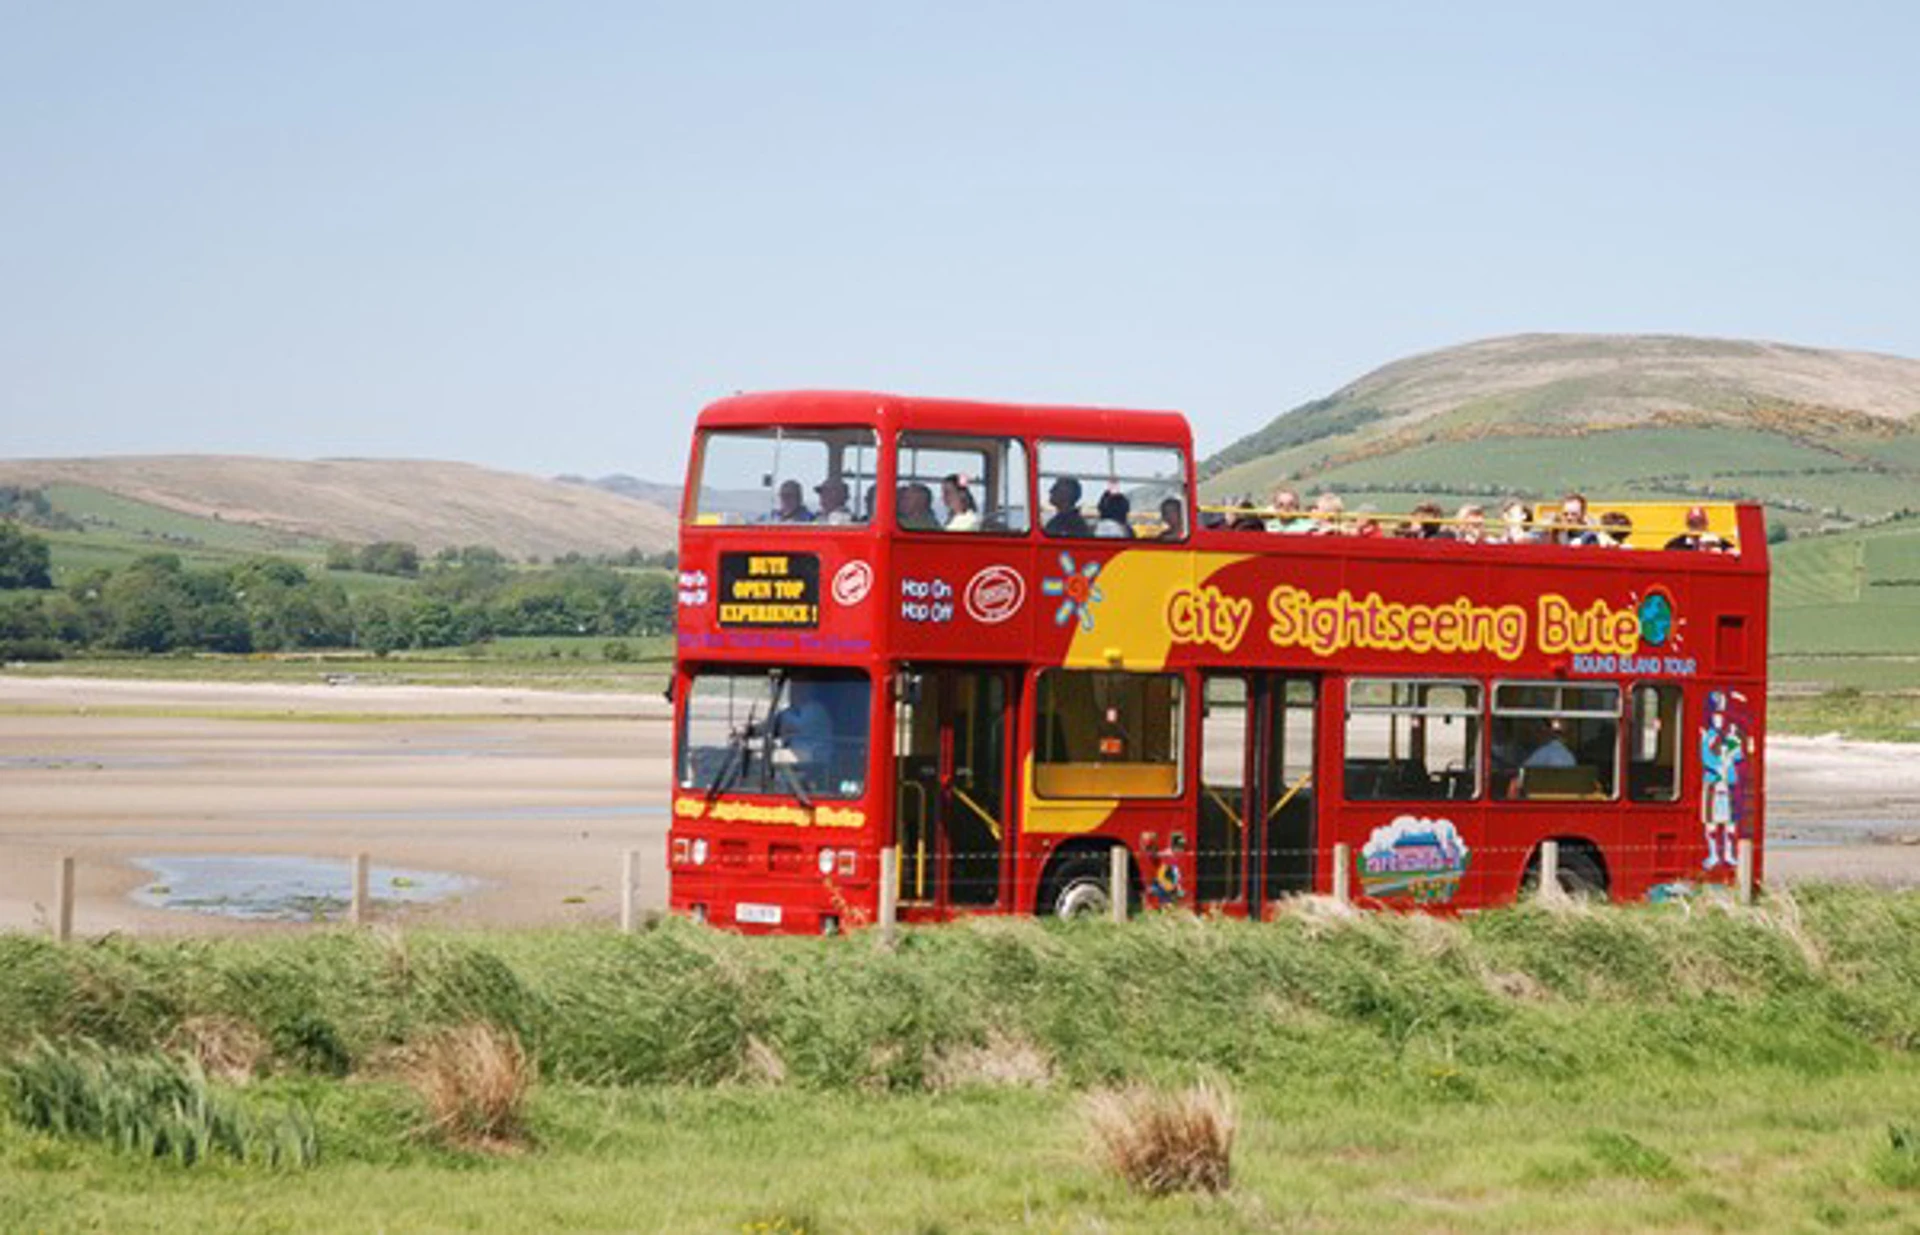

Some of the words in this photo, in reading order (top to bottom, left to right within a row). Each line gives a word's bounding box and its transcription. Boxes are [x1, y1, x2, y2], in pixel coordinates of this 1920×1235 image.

[732, 580, 771, 600] OPEN
[773, 580, 805, 600] TOP
[901, 578, 929, 600] Hop
[930, 578, 953, 599] On
[901, 601, 929, 622] Hop
[930, 601, 955, 622] Off
[1166, 584, 1252, 652] City
[1268, 585, 1528, 660] Sightseeing
[1538, 593, 1638, 654] Bute
[1574, 653, 1616, 673] ROUND
[1619, 654, 1661, 674] ISLAND
[1663, 655, 1697, 676] TOUR
